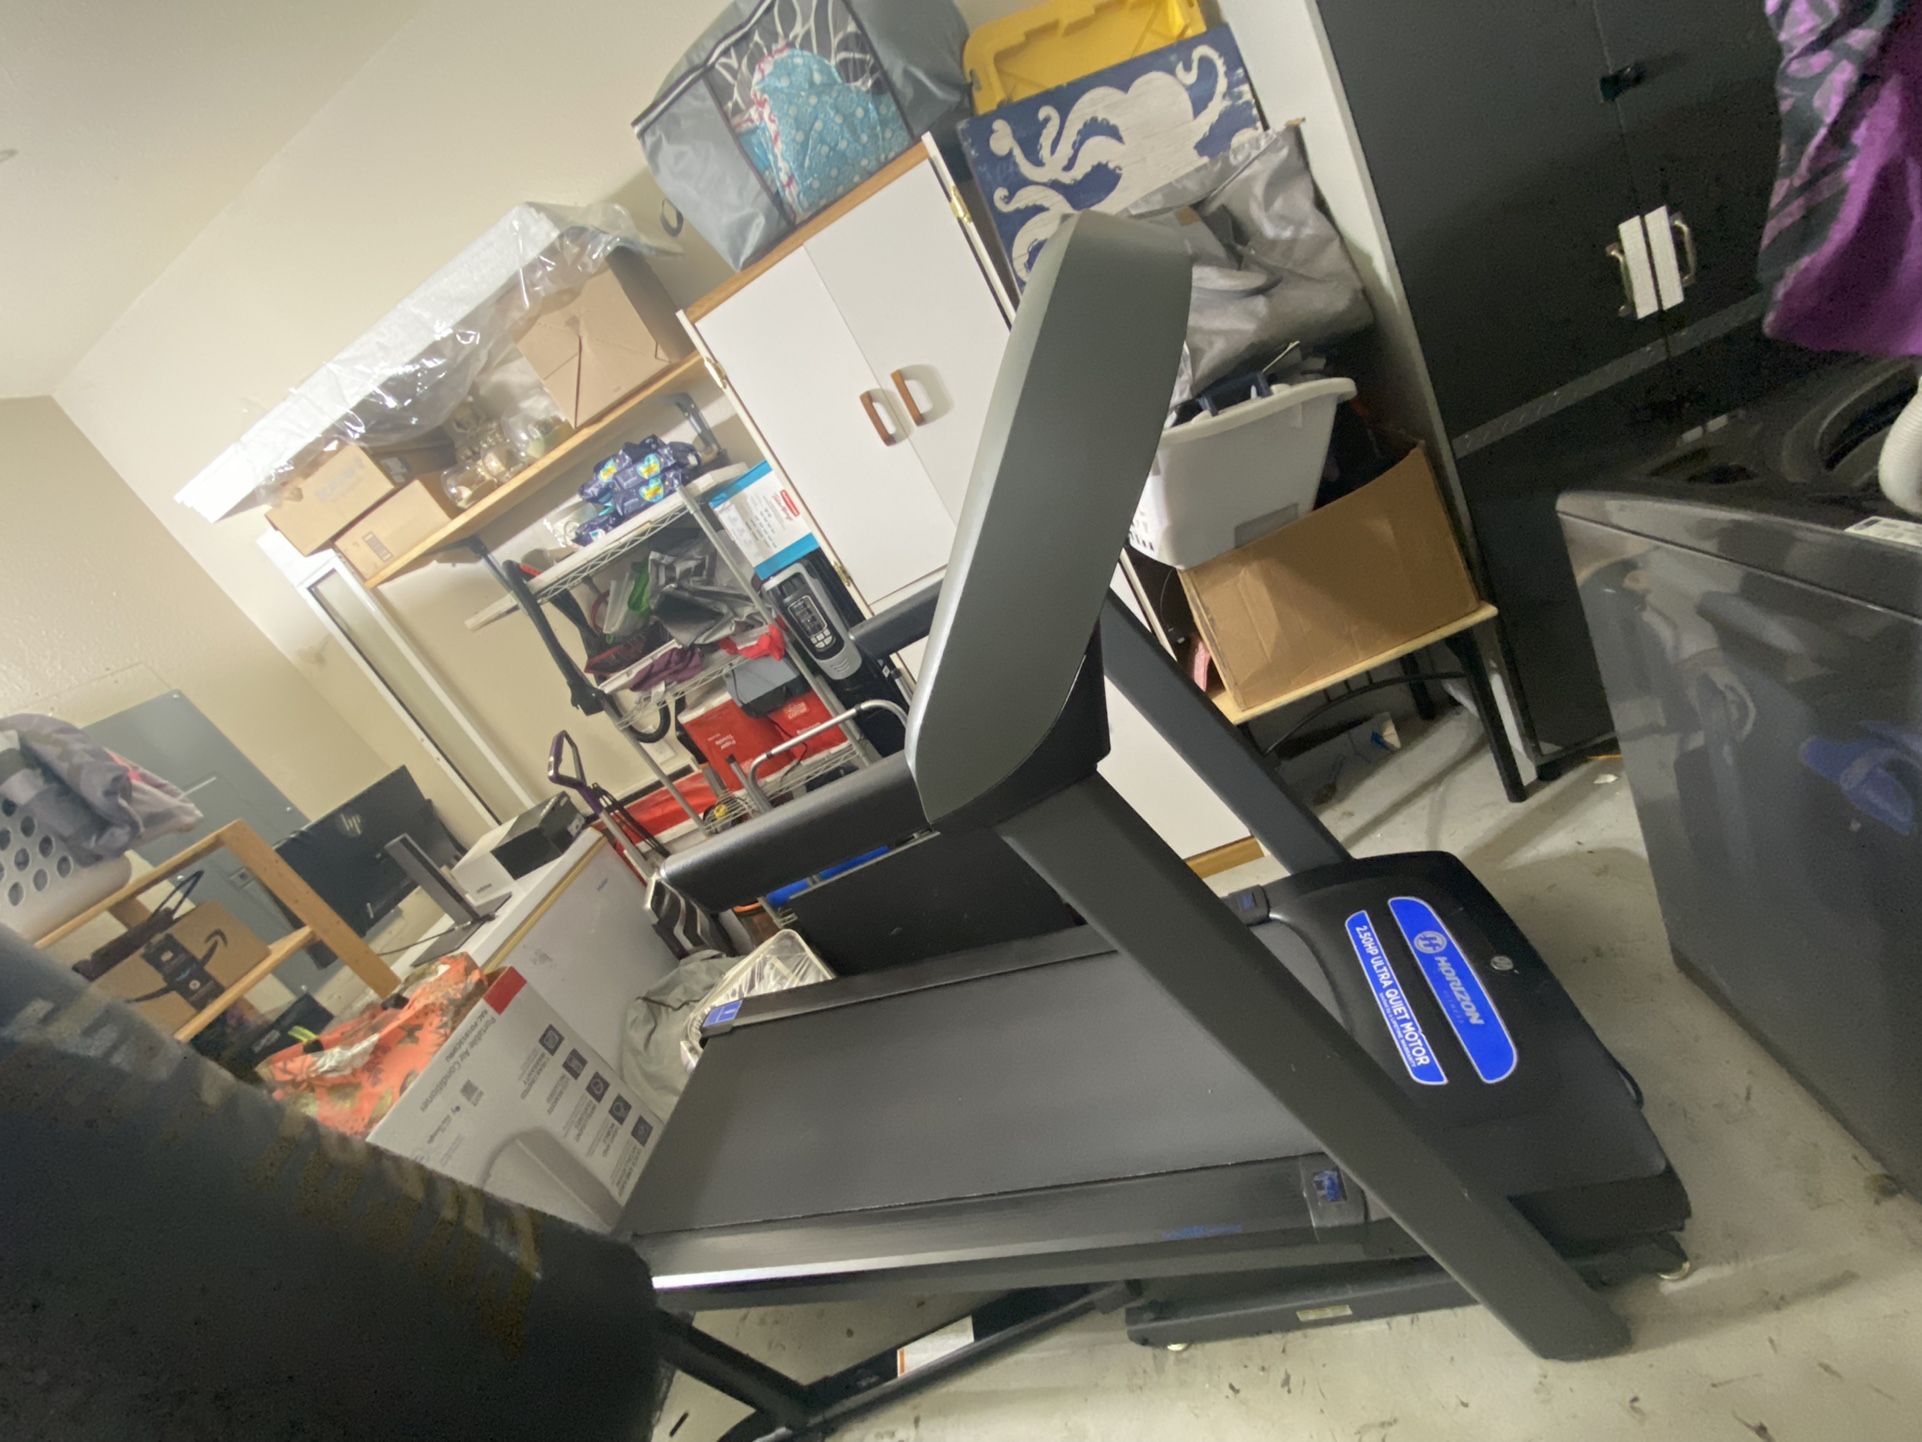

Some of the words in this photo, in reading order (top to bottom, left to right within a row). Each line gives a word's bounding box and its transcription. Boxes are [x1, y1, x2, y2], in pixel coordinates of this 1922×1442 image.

[1355, 925, 1379, 955] 2.50HP
[1370, 955, 1393, 988] ULTRA
[1385, 988, 1410, 1020] QUIET
[1400, 1021, 1430, 1066] MOTOR
[1434, 956, 1485, 1025] HORIZON
[459, 1048, 470, 1062] Air
[469, 1016, 496, 1049] Portable
[420, 1060, 461, 1112] Conditioner
